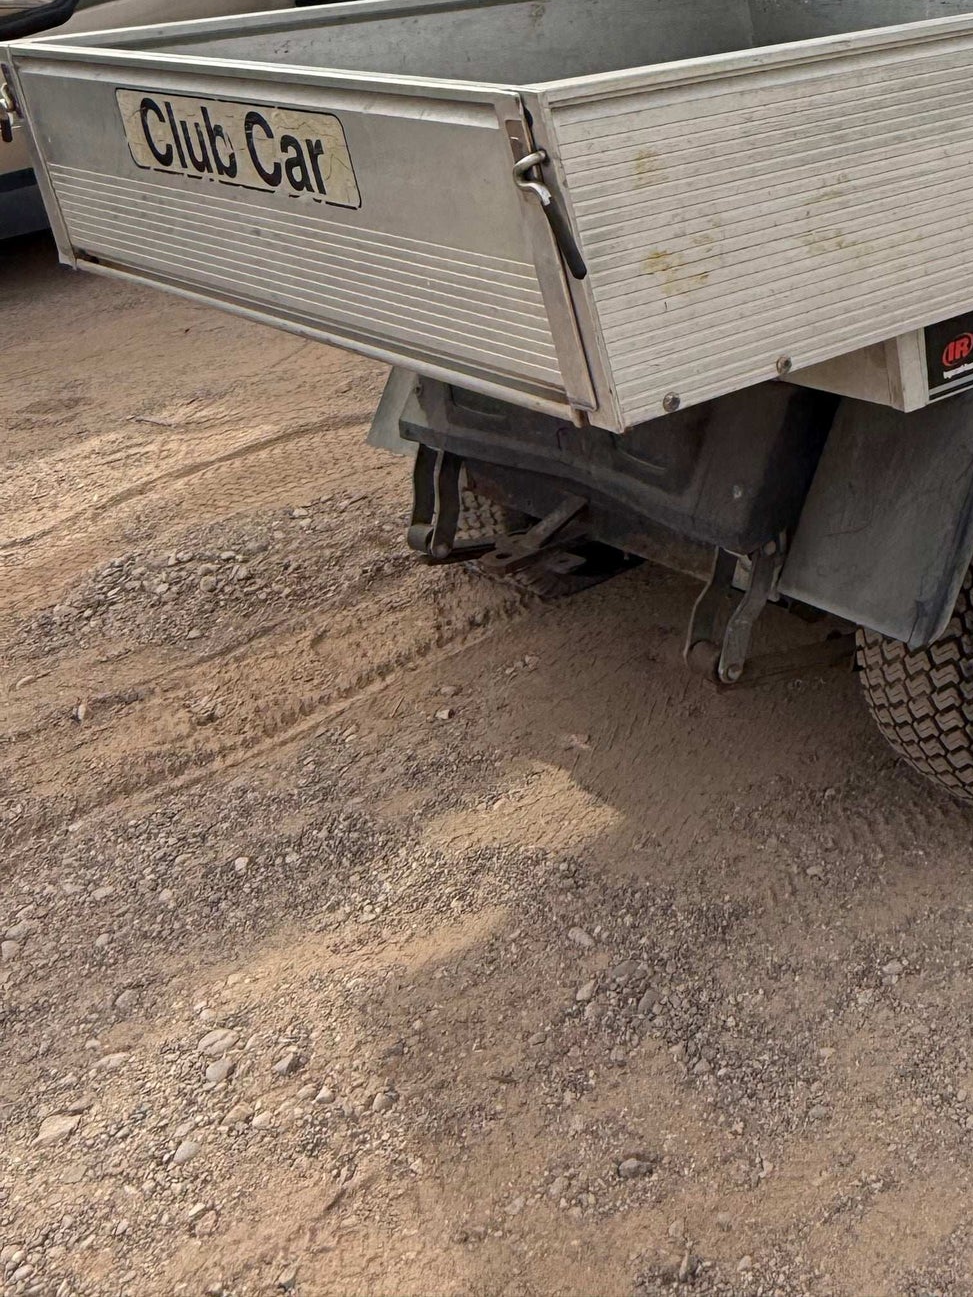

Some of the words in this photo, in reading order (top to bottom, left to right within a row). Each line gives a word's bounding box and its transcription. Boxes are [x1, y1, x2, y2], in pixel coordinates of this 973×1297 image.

[140, 98, 238, 178] Club
[244, 111, 326, 195] Car
[948, 337, 969, 362] IR
